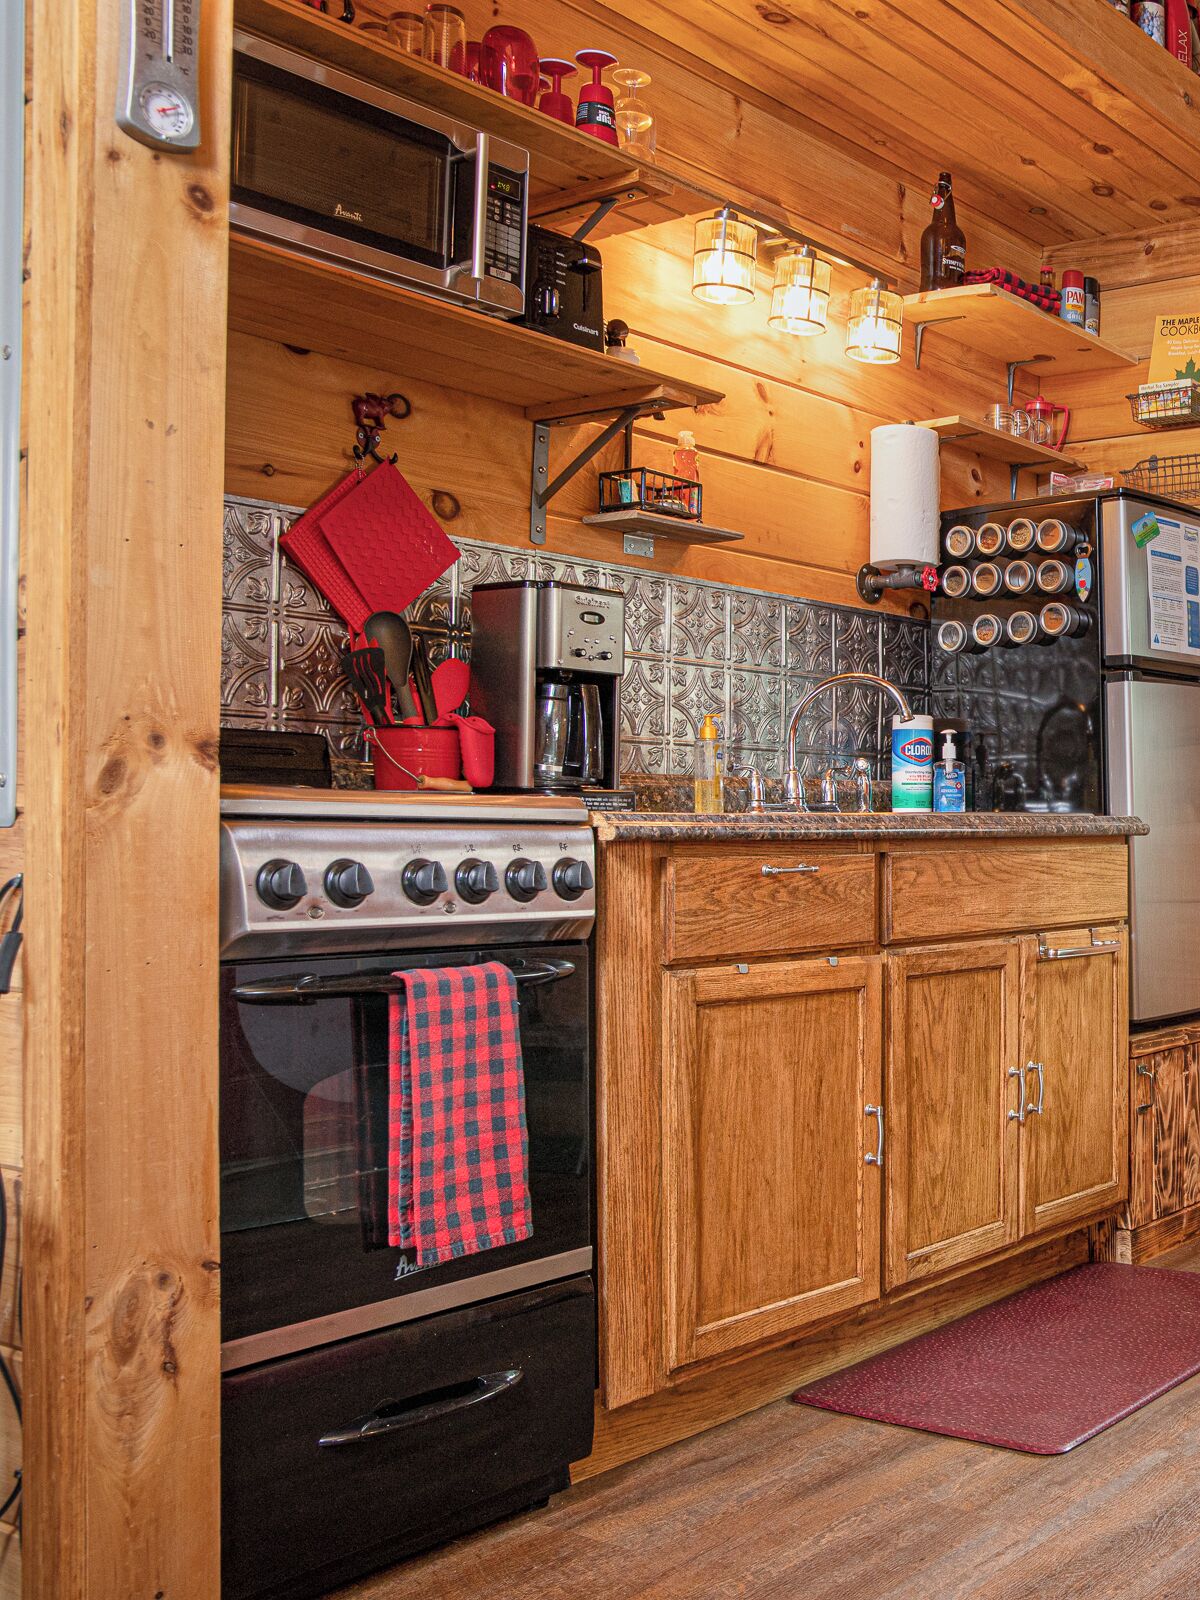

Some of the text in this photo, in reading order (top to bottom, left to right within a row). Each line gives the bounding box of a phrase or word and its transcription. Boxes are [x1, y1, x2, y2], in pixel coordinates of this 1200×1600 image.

[1178, 29, 1188, 66] ELAX
[333, 203, 363, 222] Avanti
[1177, 316, 1200, 325] MAPLE
[573, 322, 599, 337] Cuisinart
